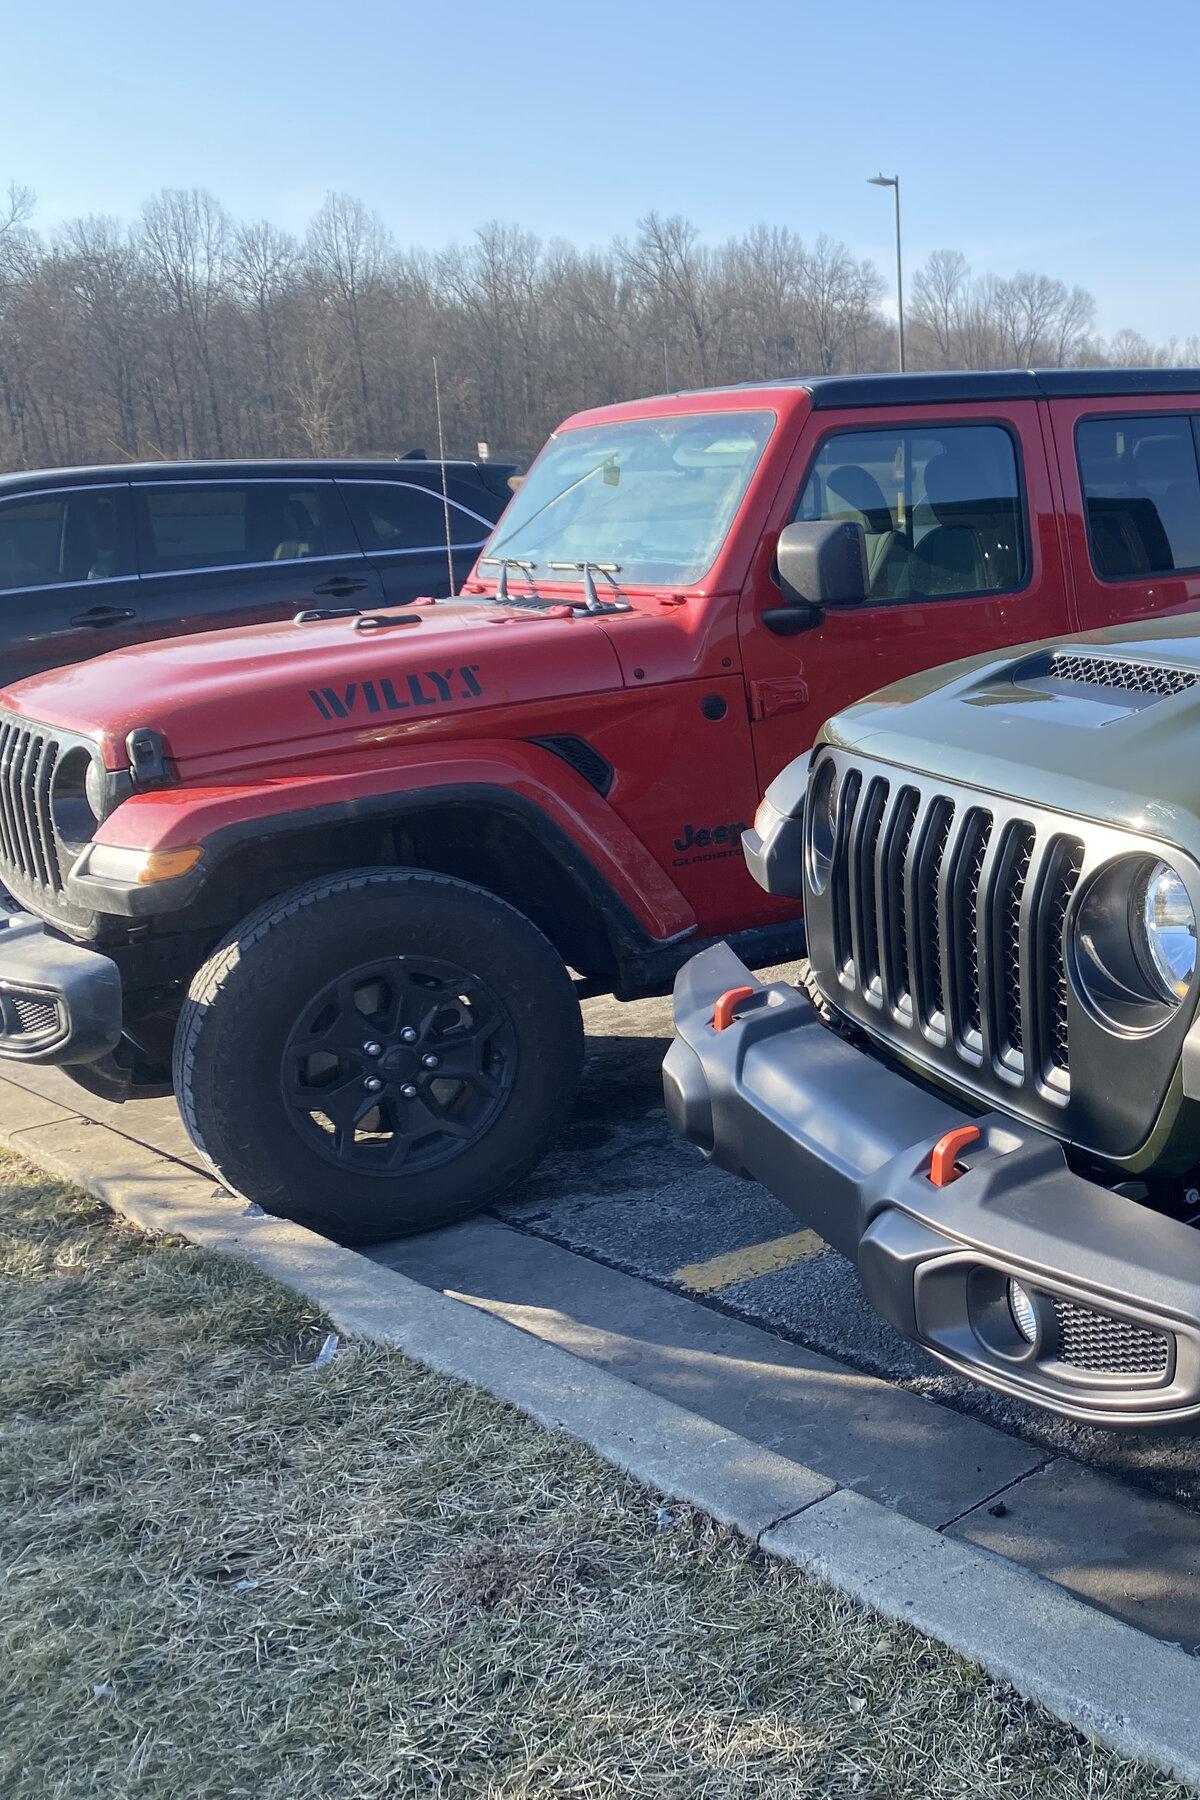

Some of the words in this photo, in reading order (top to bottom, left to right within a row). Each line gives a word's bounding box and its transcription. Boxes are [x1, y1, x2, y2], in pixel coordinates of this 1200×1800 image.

[307, 664, 482, 720] WILLYS
[673, 822, 751, 852] Jeep
[672, 847, 744, 867] GLADIATO
